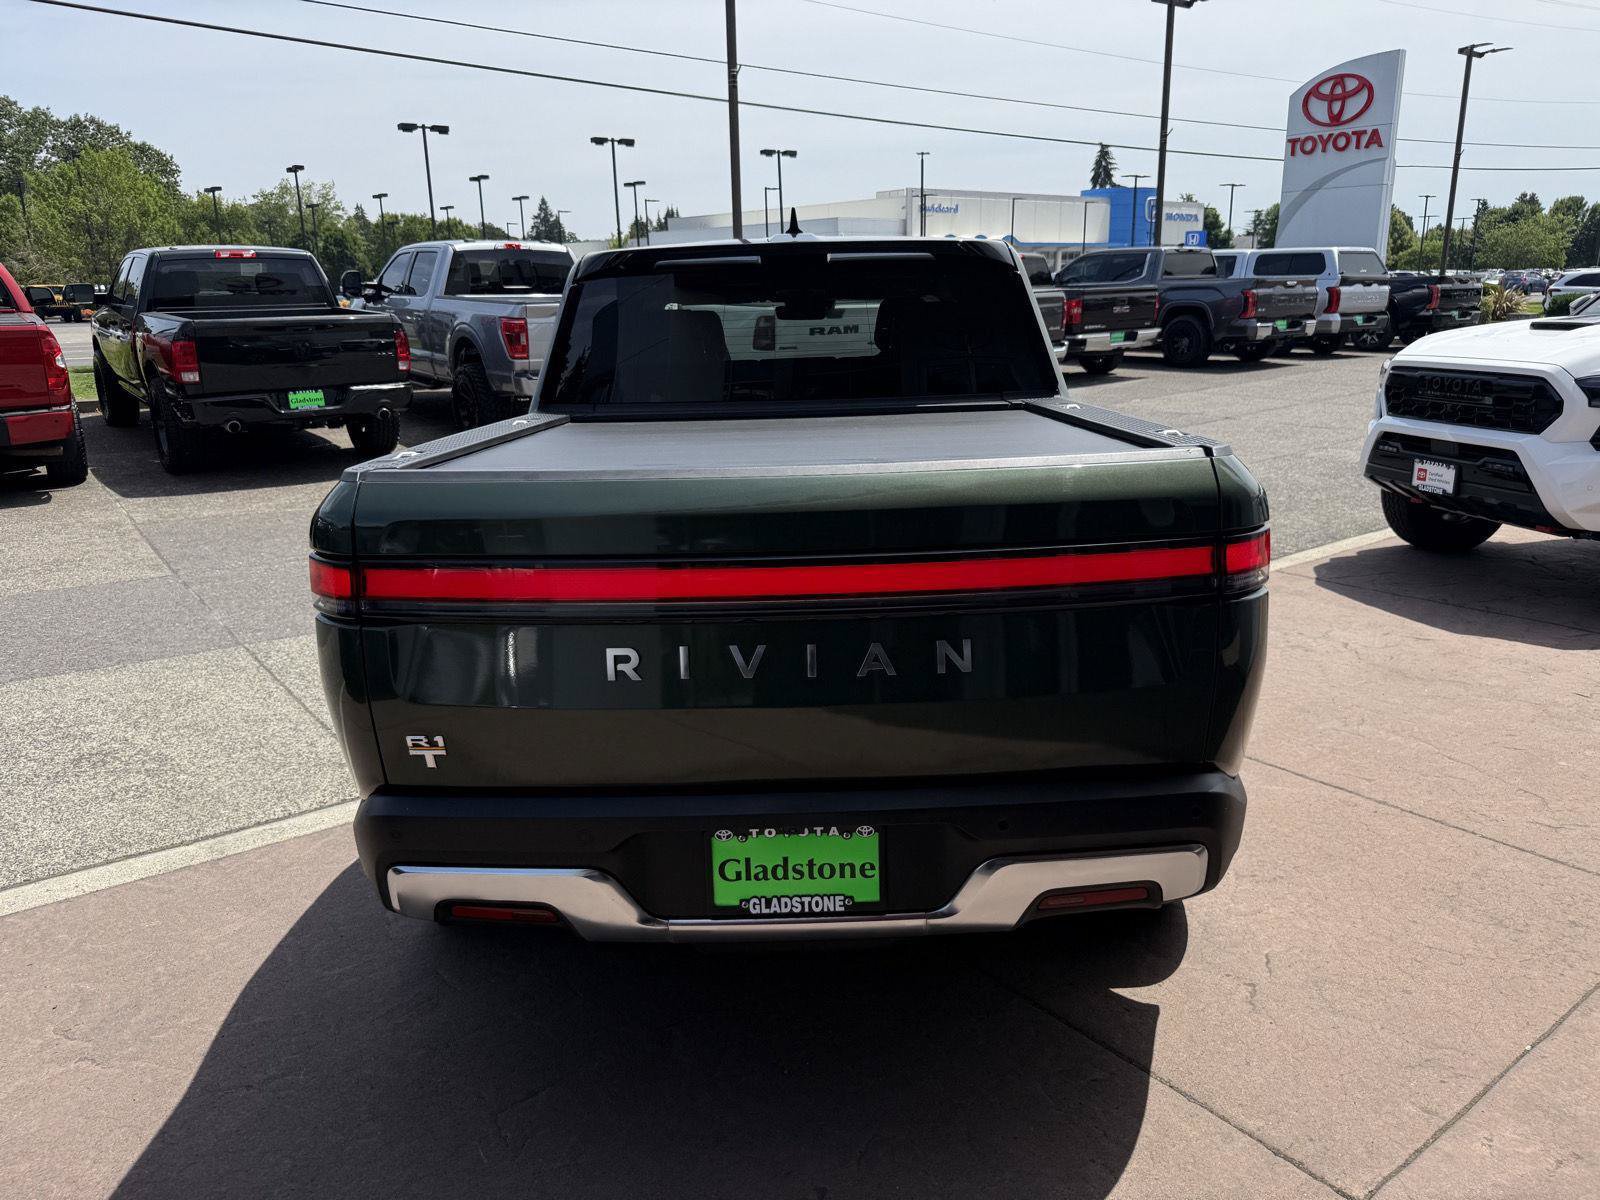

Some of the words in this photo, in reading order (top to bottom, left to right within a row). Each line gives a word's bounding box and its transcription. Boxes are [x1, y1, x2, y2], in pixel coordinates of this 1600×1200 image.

[1287, 127, 1384, 157] TOYOTA
[1165, 212, 1199, 222] HONDA
[809, 324, 859, 336] RAM
[1424, 376, 1482, 393] TOYOTA
[605, 639, 973, 682] RIVIAN
[749, 826, 840, 838] TOOTA
[718, 856, 876, 882] Gladstone
[749, 895, 845, 914] GLADSTONE
